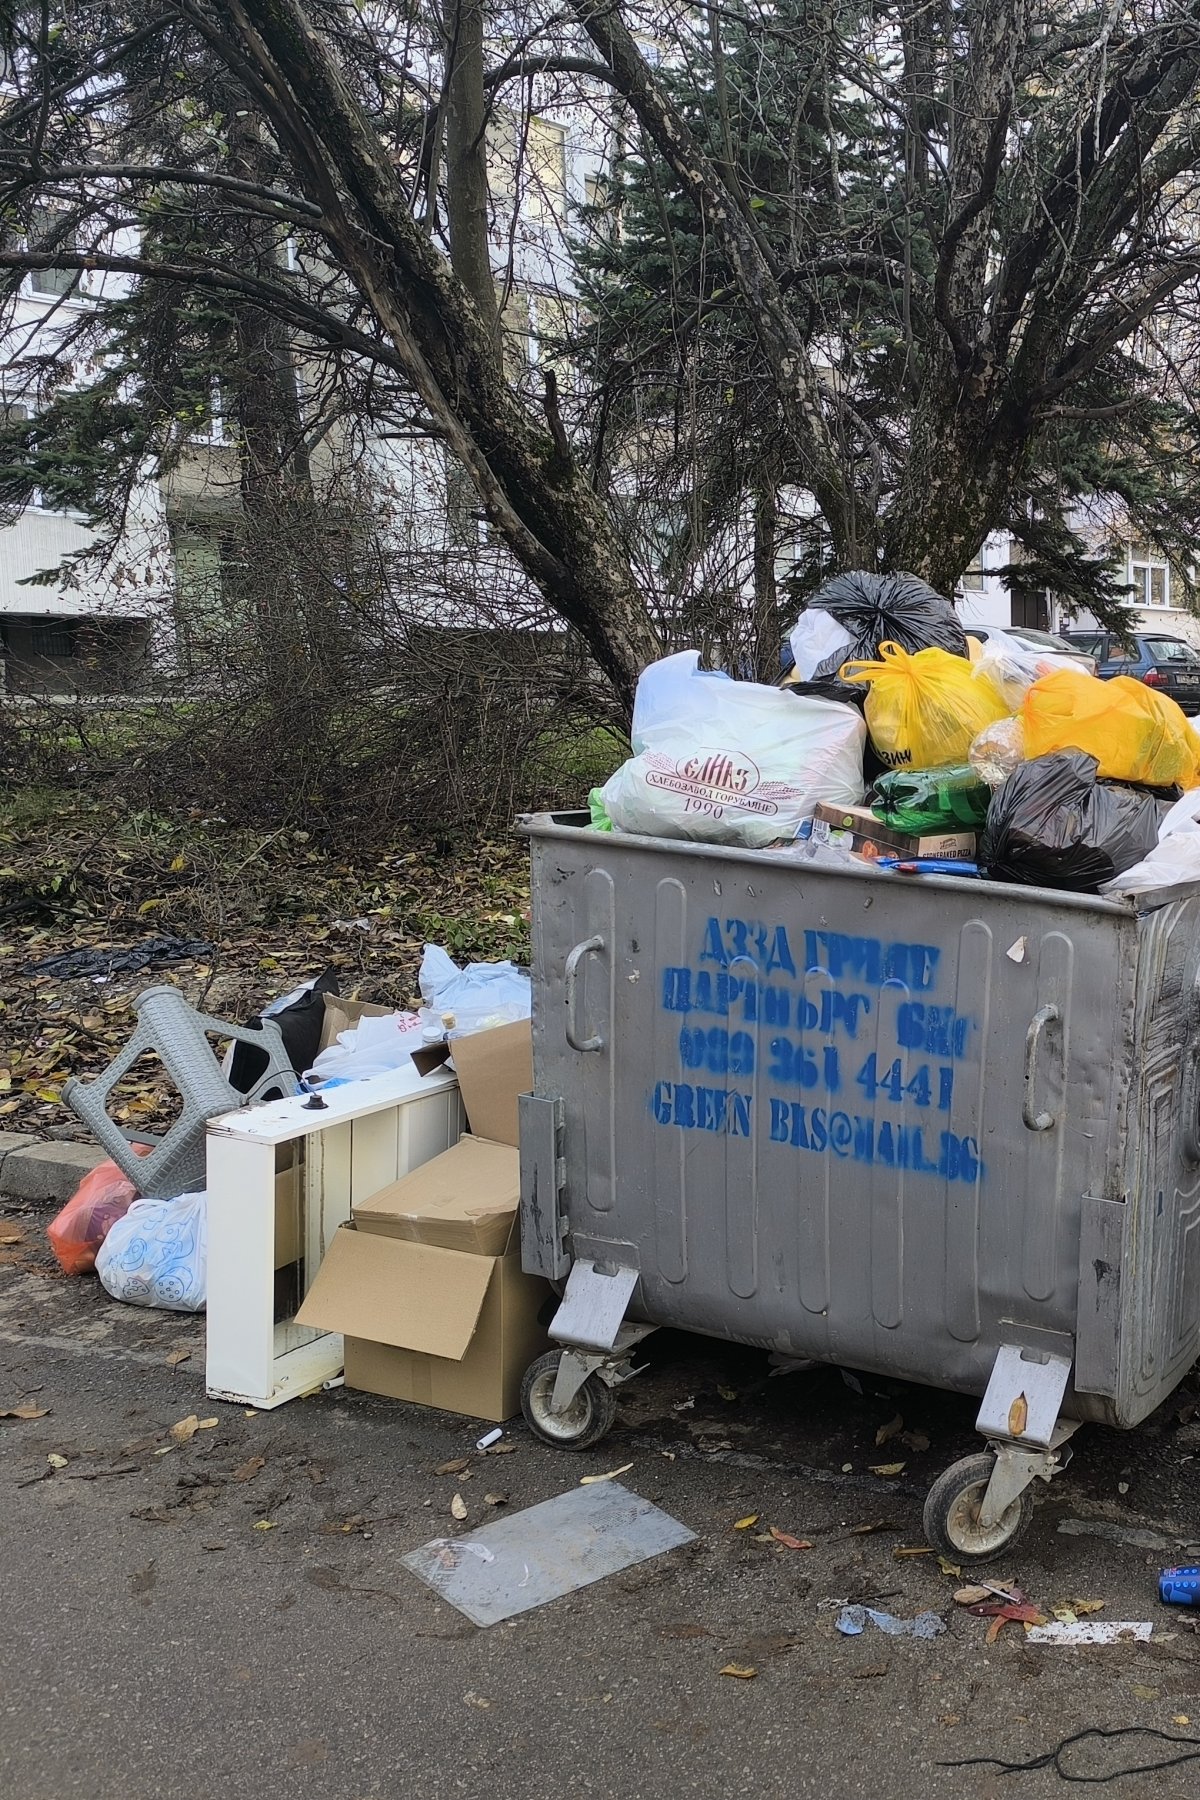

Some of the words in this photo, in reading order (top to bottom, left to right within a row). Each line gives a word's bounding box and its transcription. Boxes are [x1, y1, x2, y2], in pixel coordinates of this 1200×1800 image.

[649, 774, 712, 798] ХЛЕБОЗАВОД
[684, 798, 724, 819] 1990
[957, 848, 971, 858] PIZZA
[679, 1023, 755, 1074] 089
[768, 1035, 840, 1093] 361
[856, 1052, 954, 1111] 4441
[654, 1080, 752, 1138] GREEN
